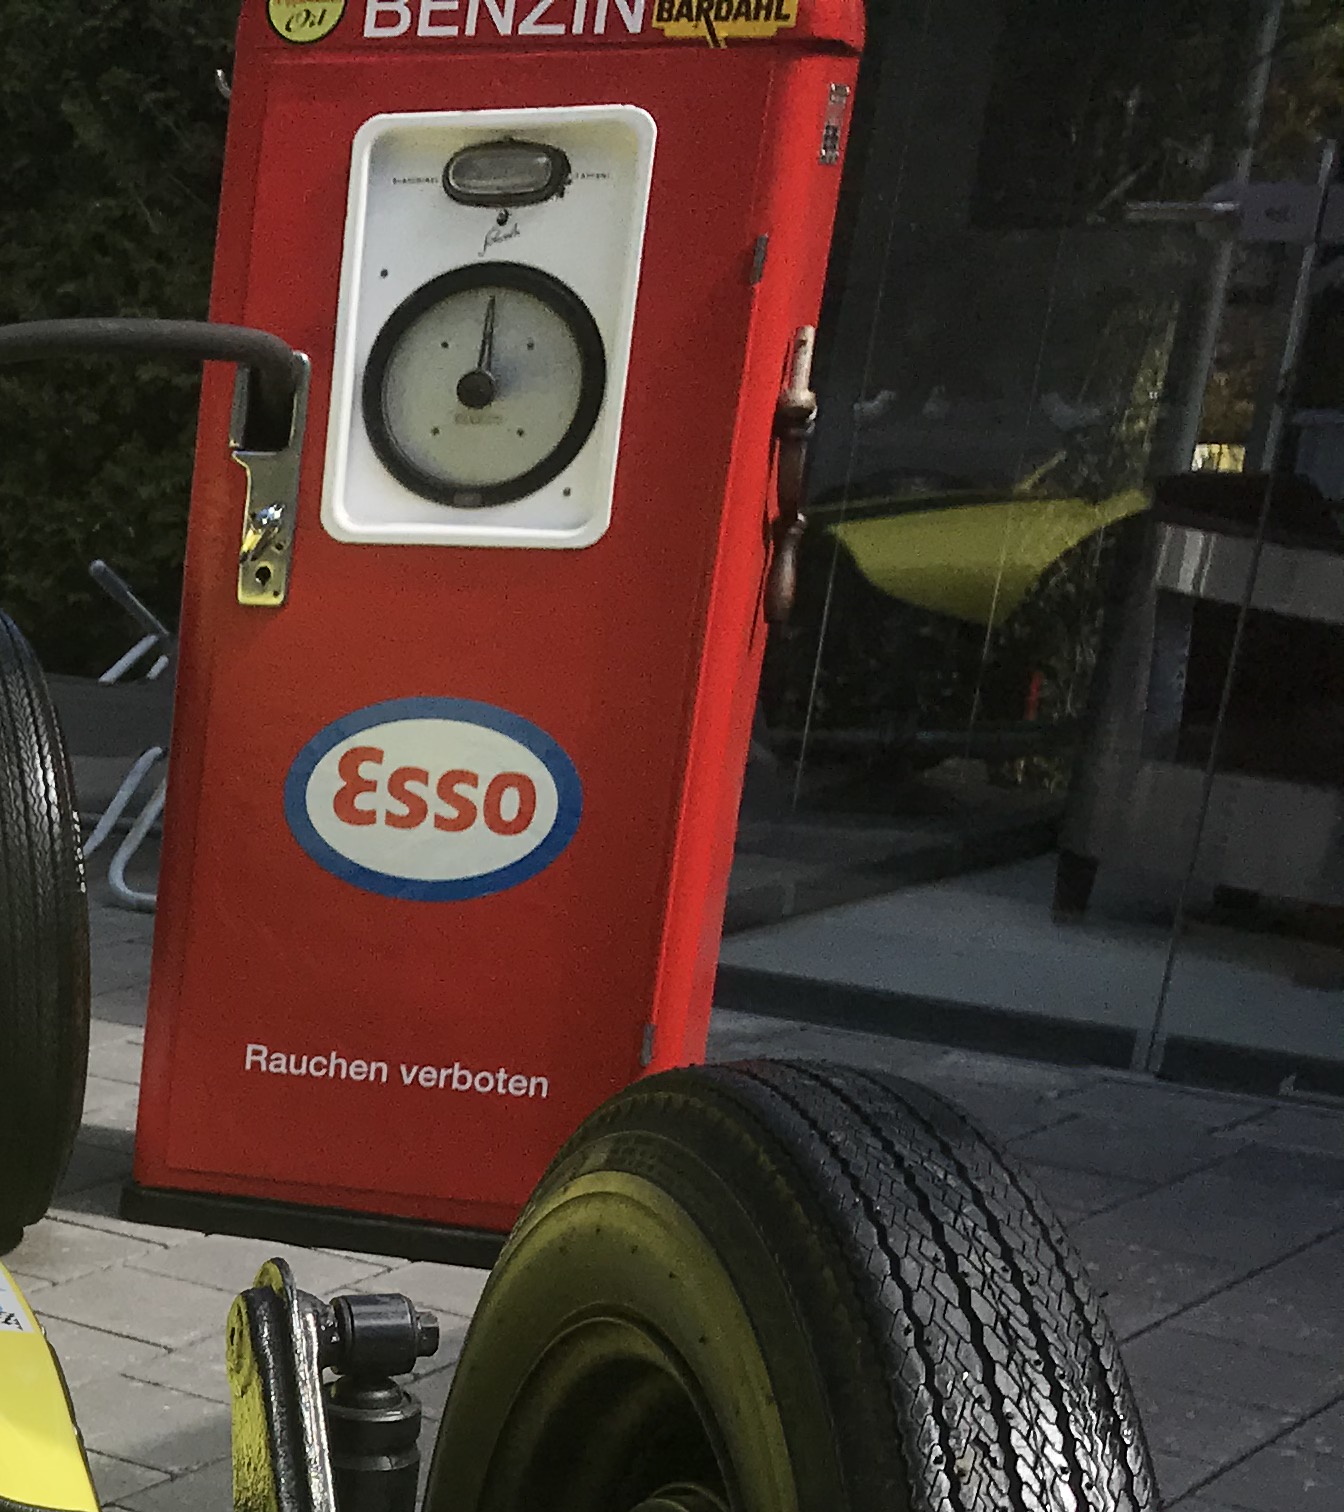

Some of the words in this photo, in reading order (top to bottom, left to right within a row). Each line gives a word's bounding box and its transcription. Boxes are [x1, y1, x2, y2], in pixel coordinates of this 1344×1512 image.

[656, 0, 791, 44] BARDAHL
[244, 1043, 389, 1084] Rauchen
[400, 1061, 550, 1099] verboten
